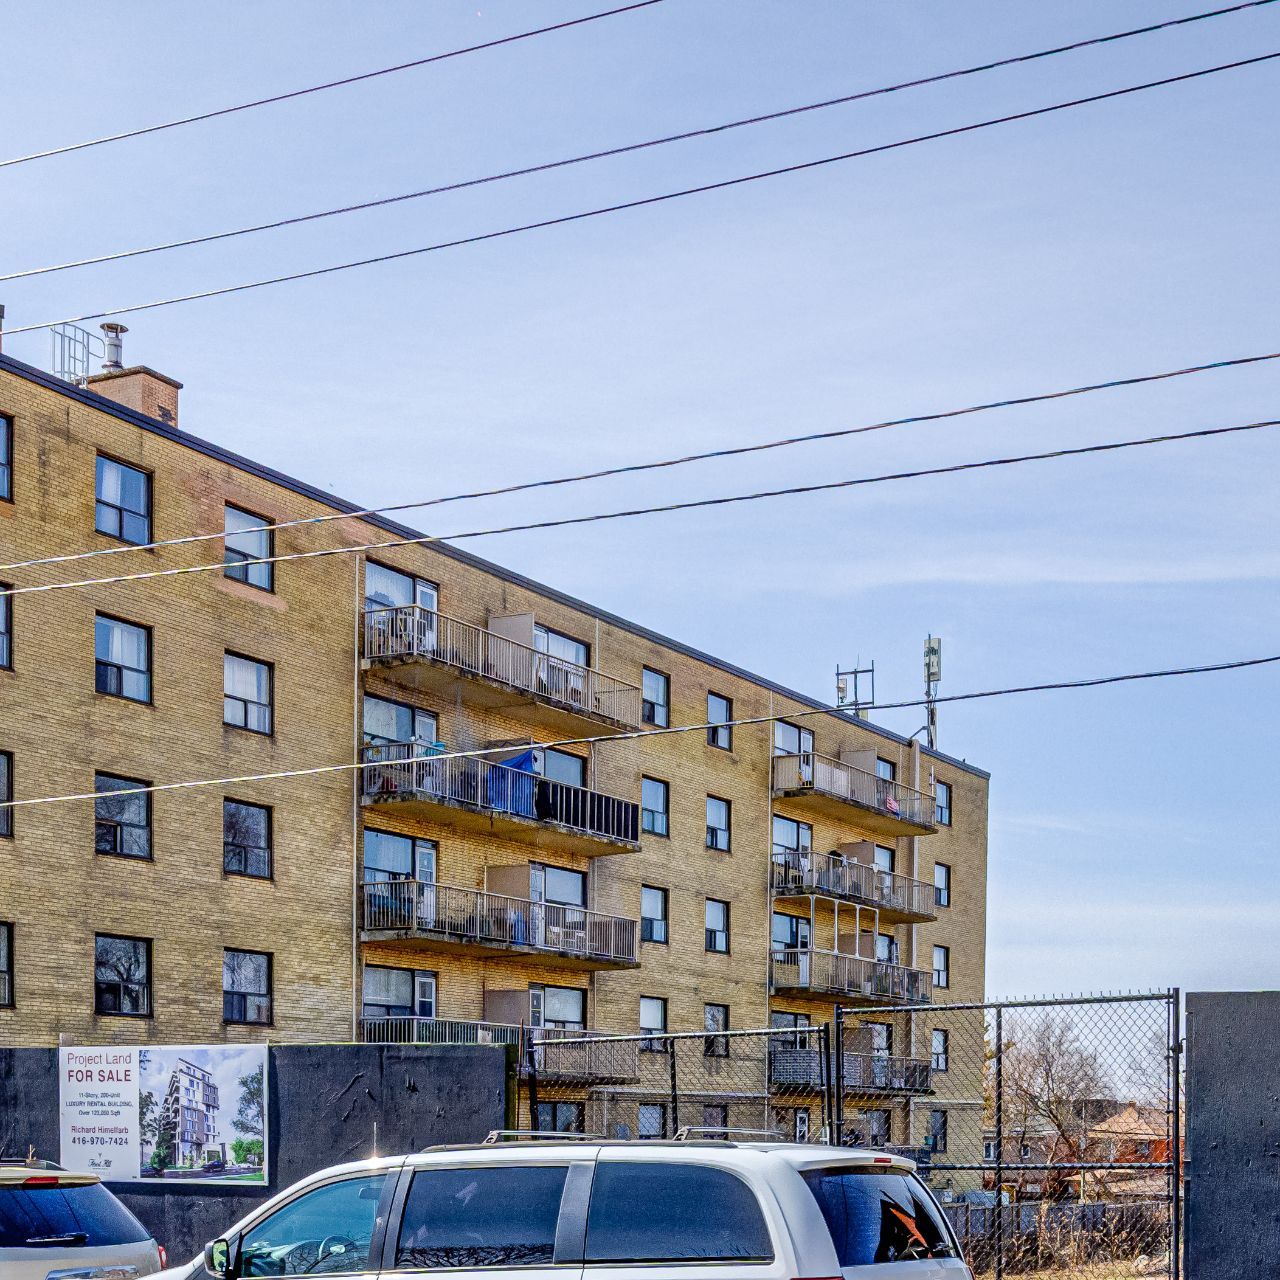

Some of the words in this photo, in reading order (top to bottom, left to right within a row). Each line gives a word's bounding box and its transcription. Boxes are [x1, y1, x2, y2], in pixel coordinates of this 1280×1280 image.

[67, 1052, 102, 1067] Project
[106, 1052, 132, 1065] Land
[67, 1070, 93, 1082] FOR
[98, 1069, 132, 1082] SALE
[71, 1126, 96, 1134] Richard
[98, 1126, 129, 1134] Himelfarb
[71, 1136, 129, 1146] 416-970-7424
